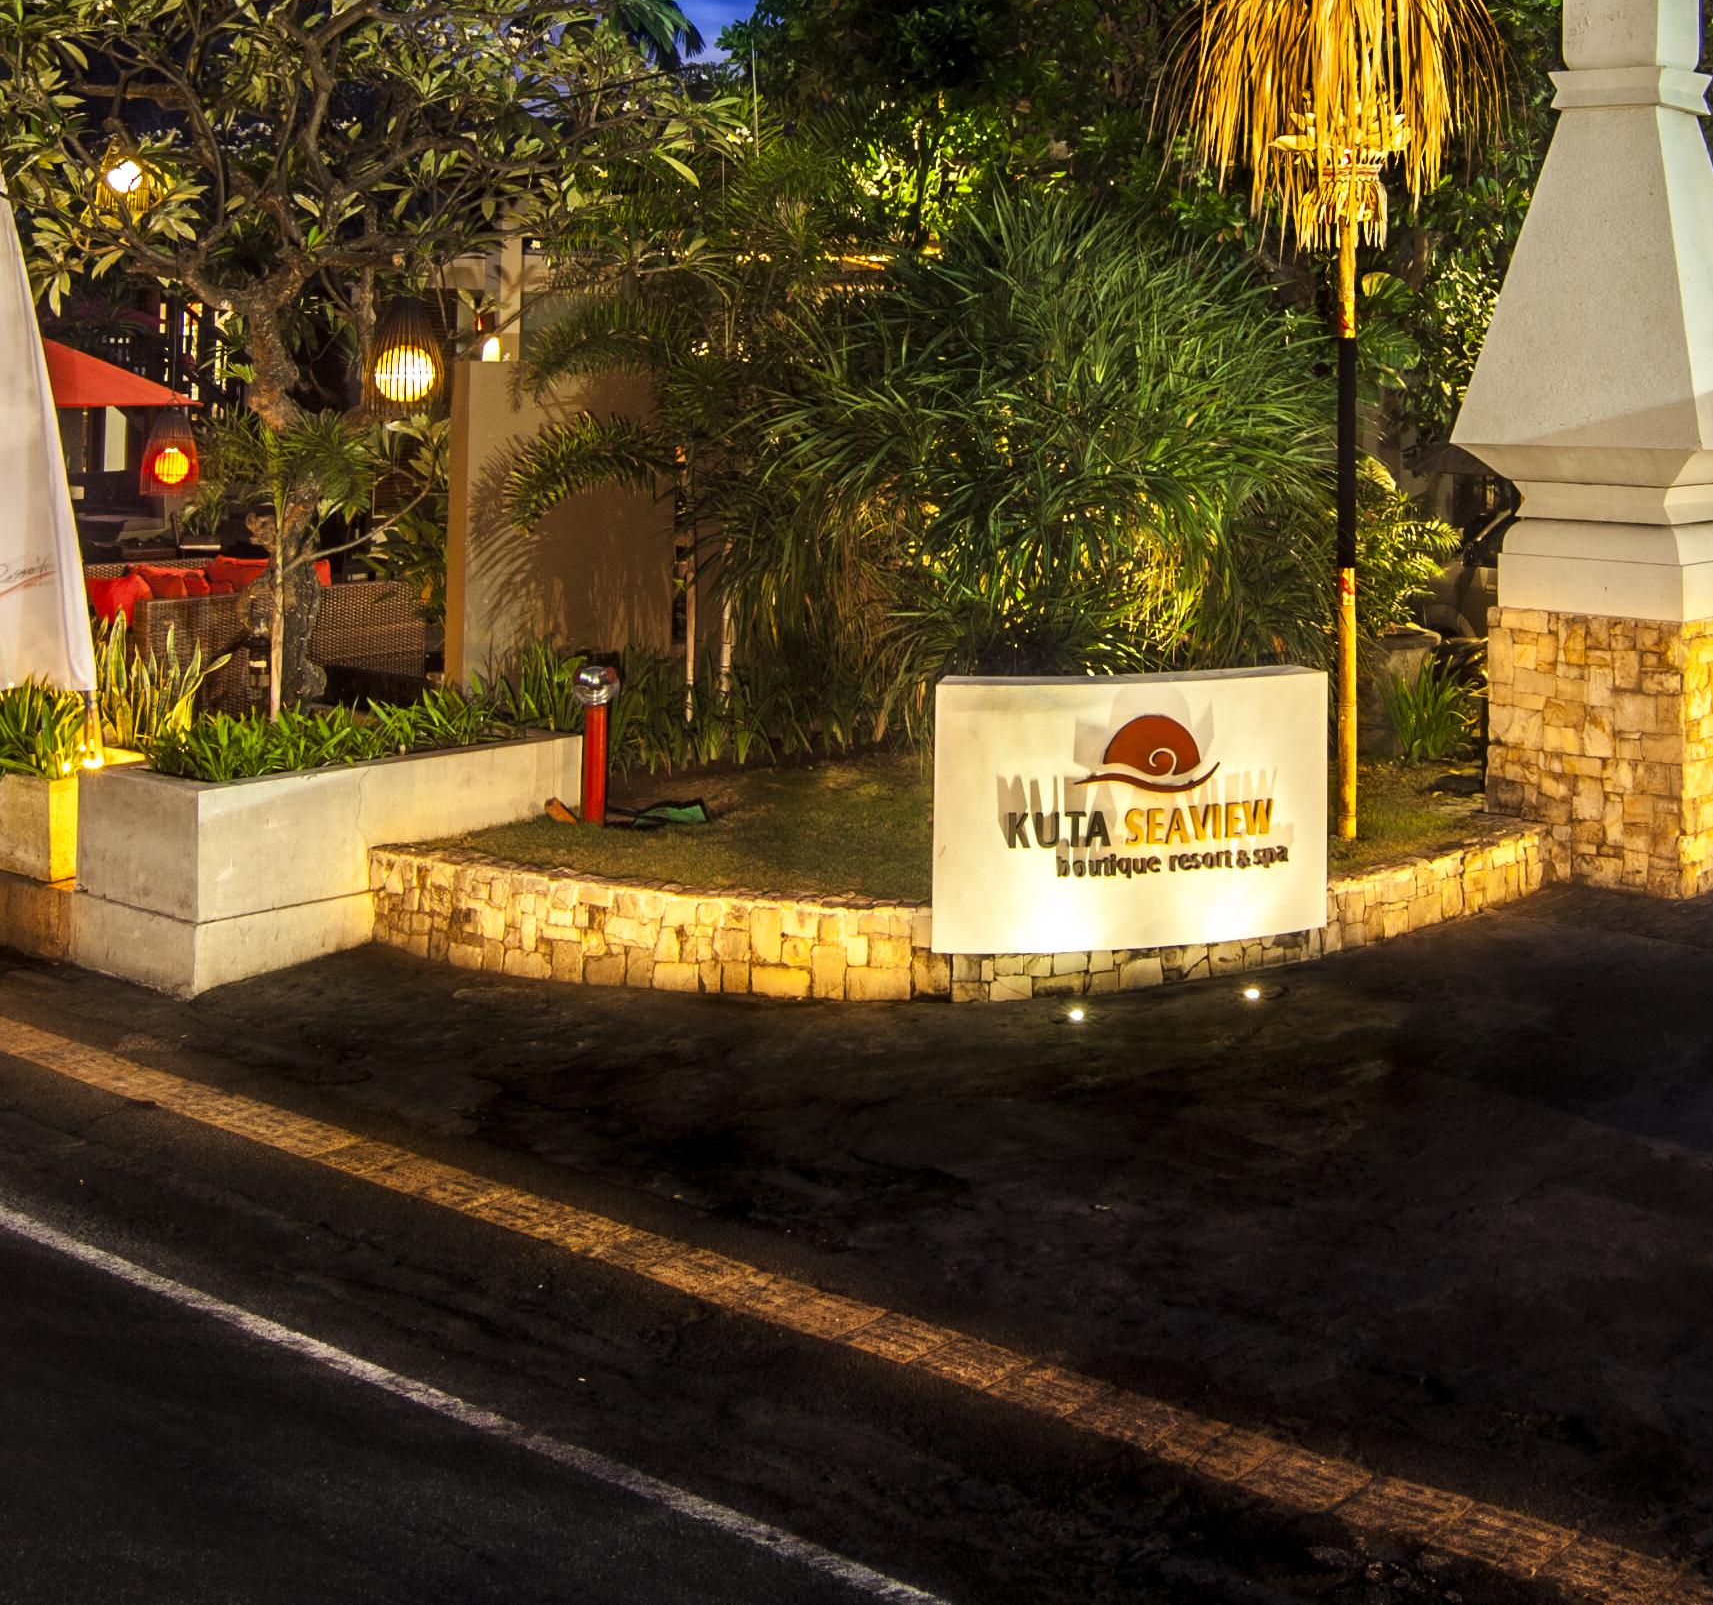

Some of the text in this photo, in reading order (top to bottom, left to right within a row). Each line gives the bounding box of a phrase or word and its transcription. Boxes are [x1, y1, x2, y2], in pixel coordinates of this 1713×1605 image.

[1007, 798, 1273, 848] KUTA SEAVIEW
[1056, 845, 1289, 878] boutique resort & spa
